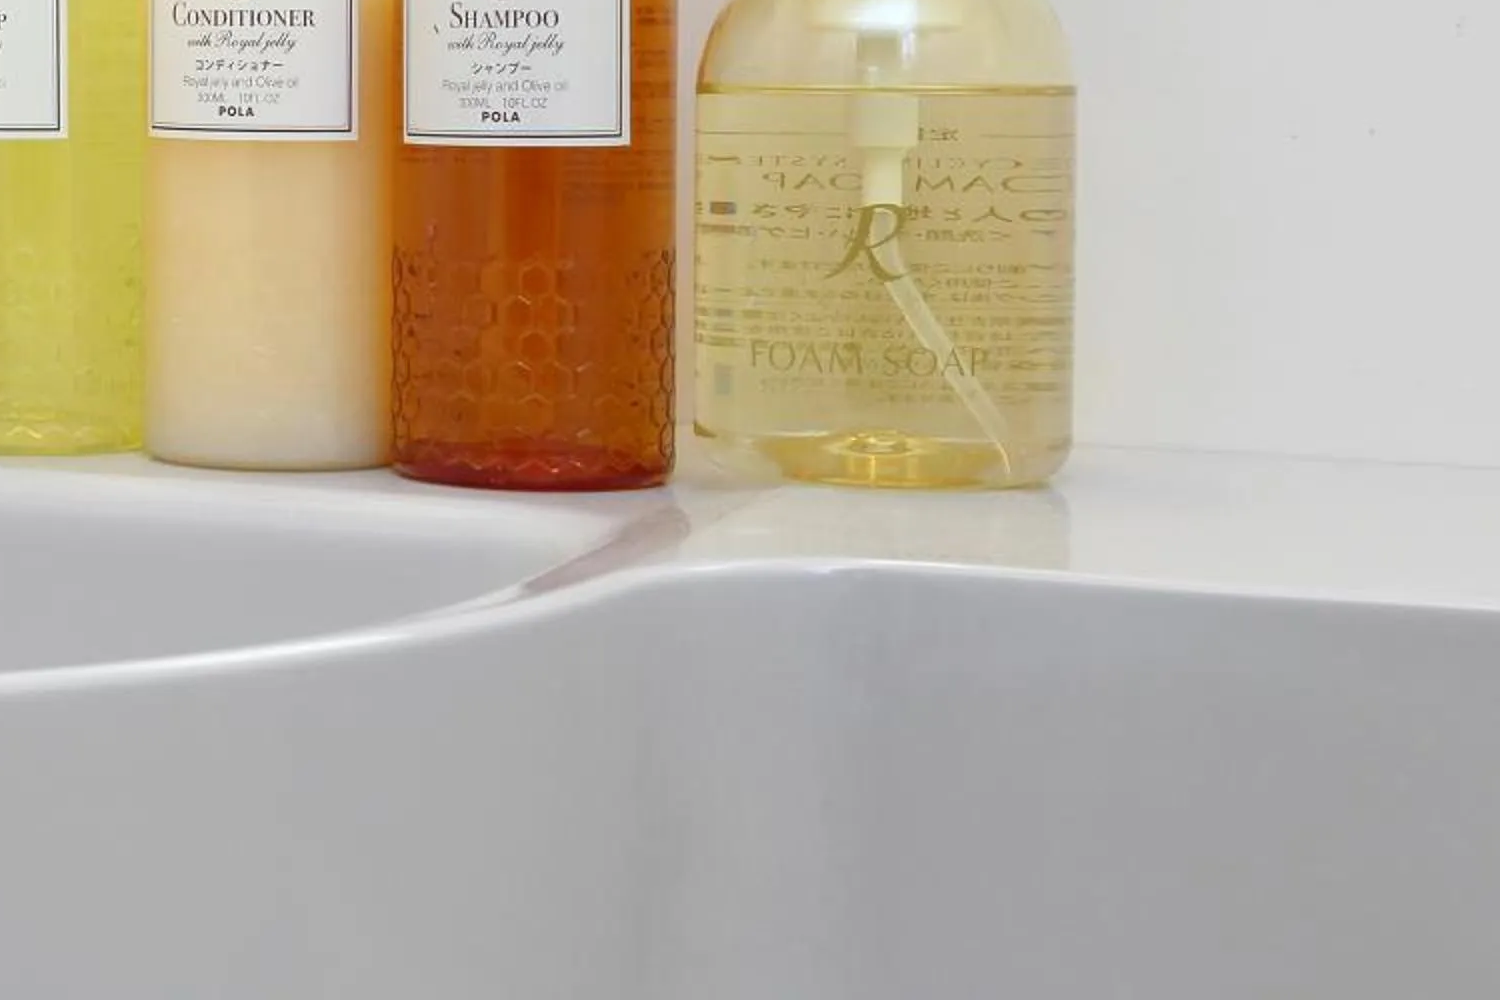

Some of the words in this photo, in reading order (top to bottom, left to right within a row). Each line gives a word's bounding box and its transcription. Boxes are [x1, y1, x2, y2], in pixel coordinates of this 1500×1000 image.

[172, 1, 316, 27] CONDITIONER
[449, 1, 559, 29] SHAMPOO
[218, 105, 255, 117] POLA
[481, 111, 521, 123] POLA
[750, 341, 863, 375] FOAM
[883, 345, 988, 377] SOAP
